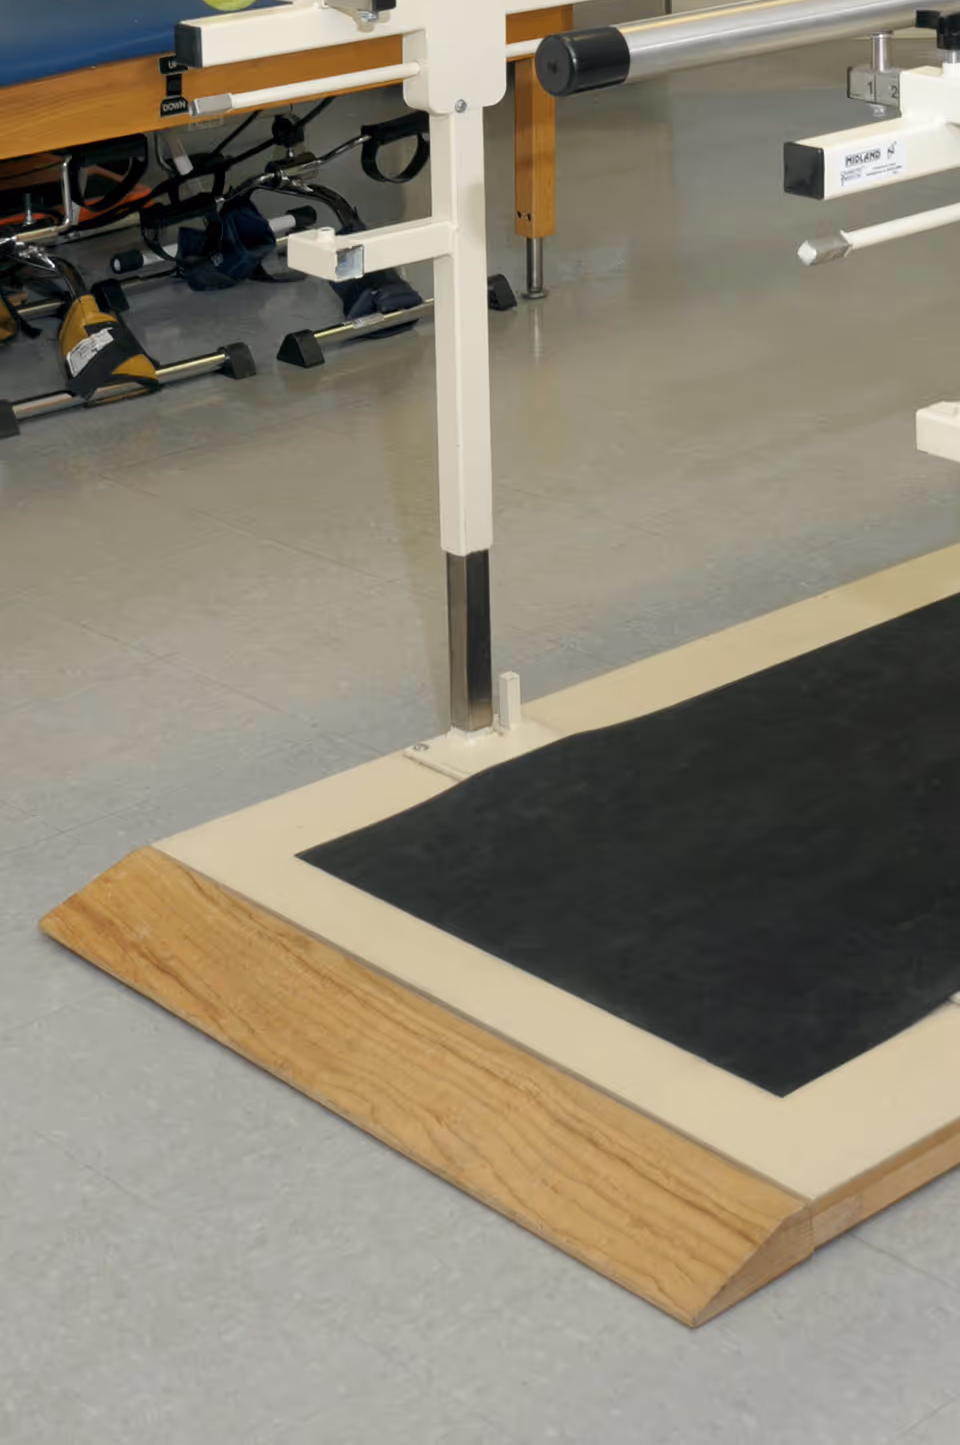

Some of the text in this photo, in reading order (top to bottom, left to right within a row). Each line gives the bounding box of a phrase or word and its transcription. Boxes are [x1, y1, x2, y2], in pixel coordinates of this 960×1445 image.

[867, 81, 899, 99] 1 2
[163, 100, 186, 112] DOWN
